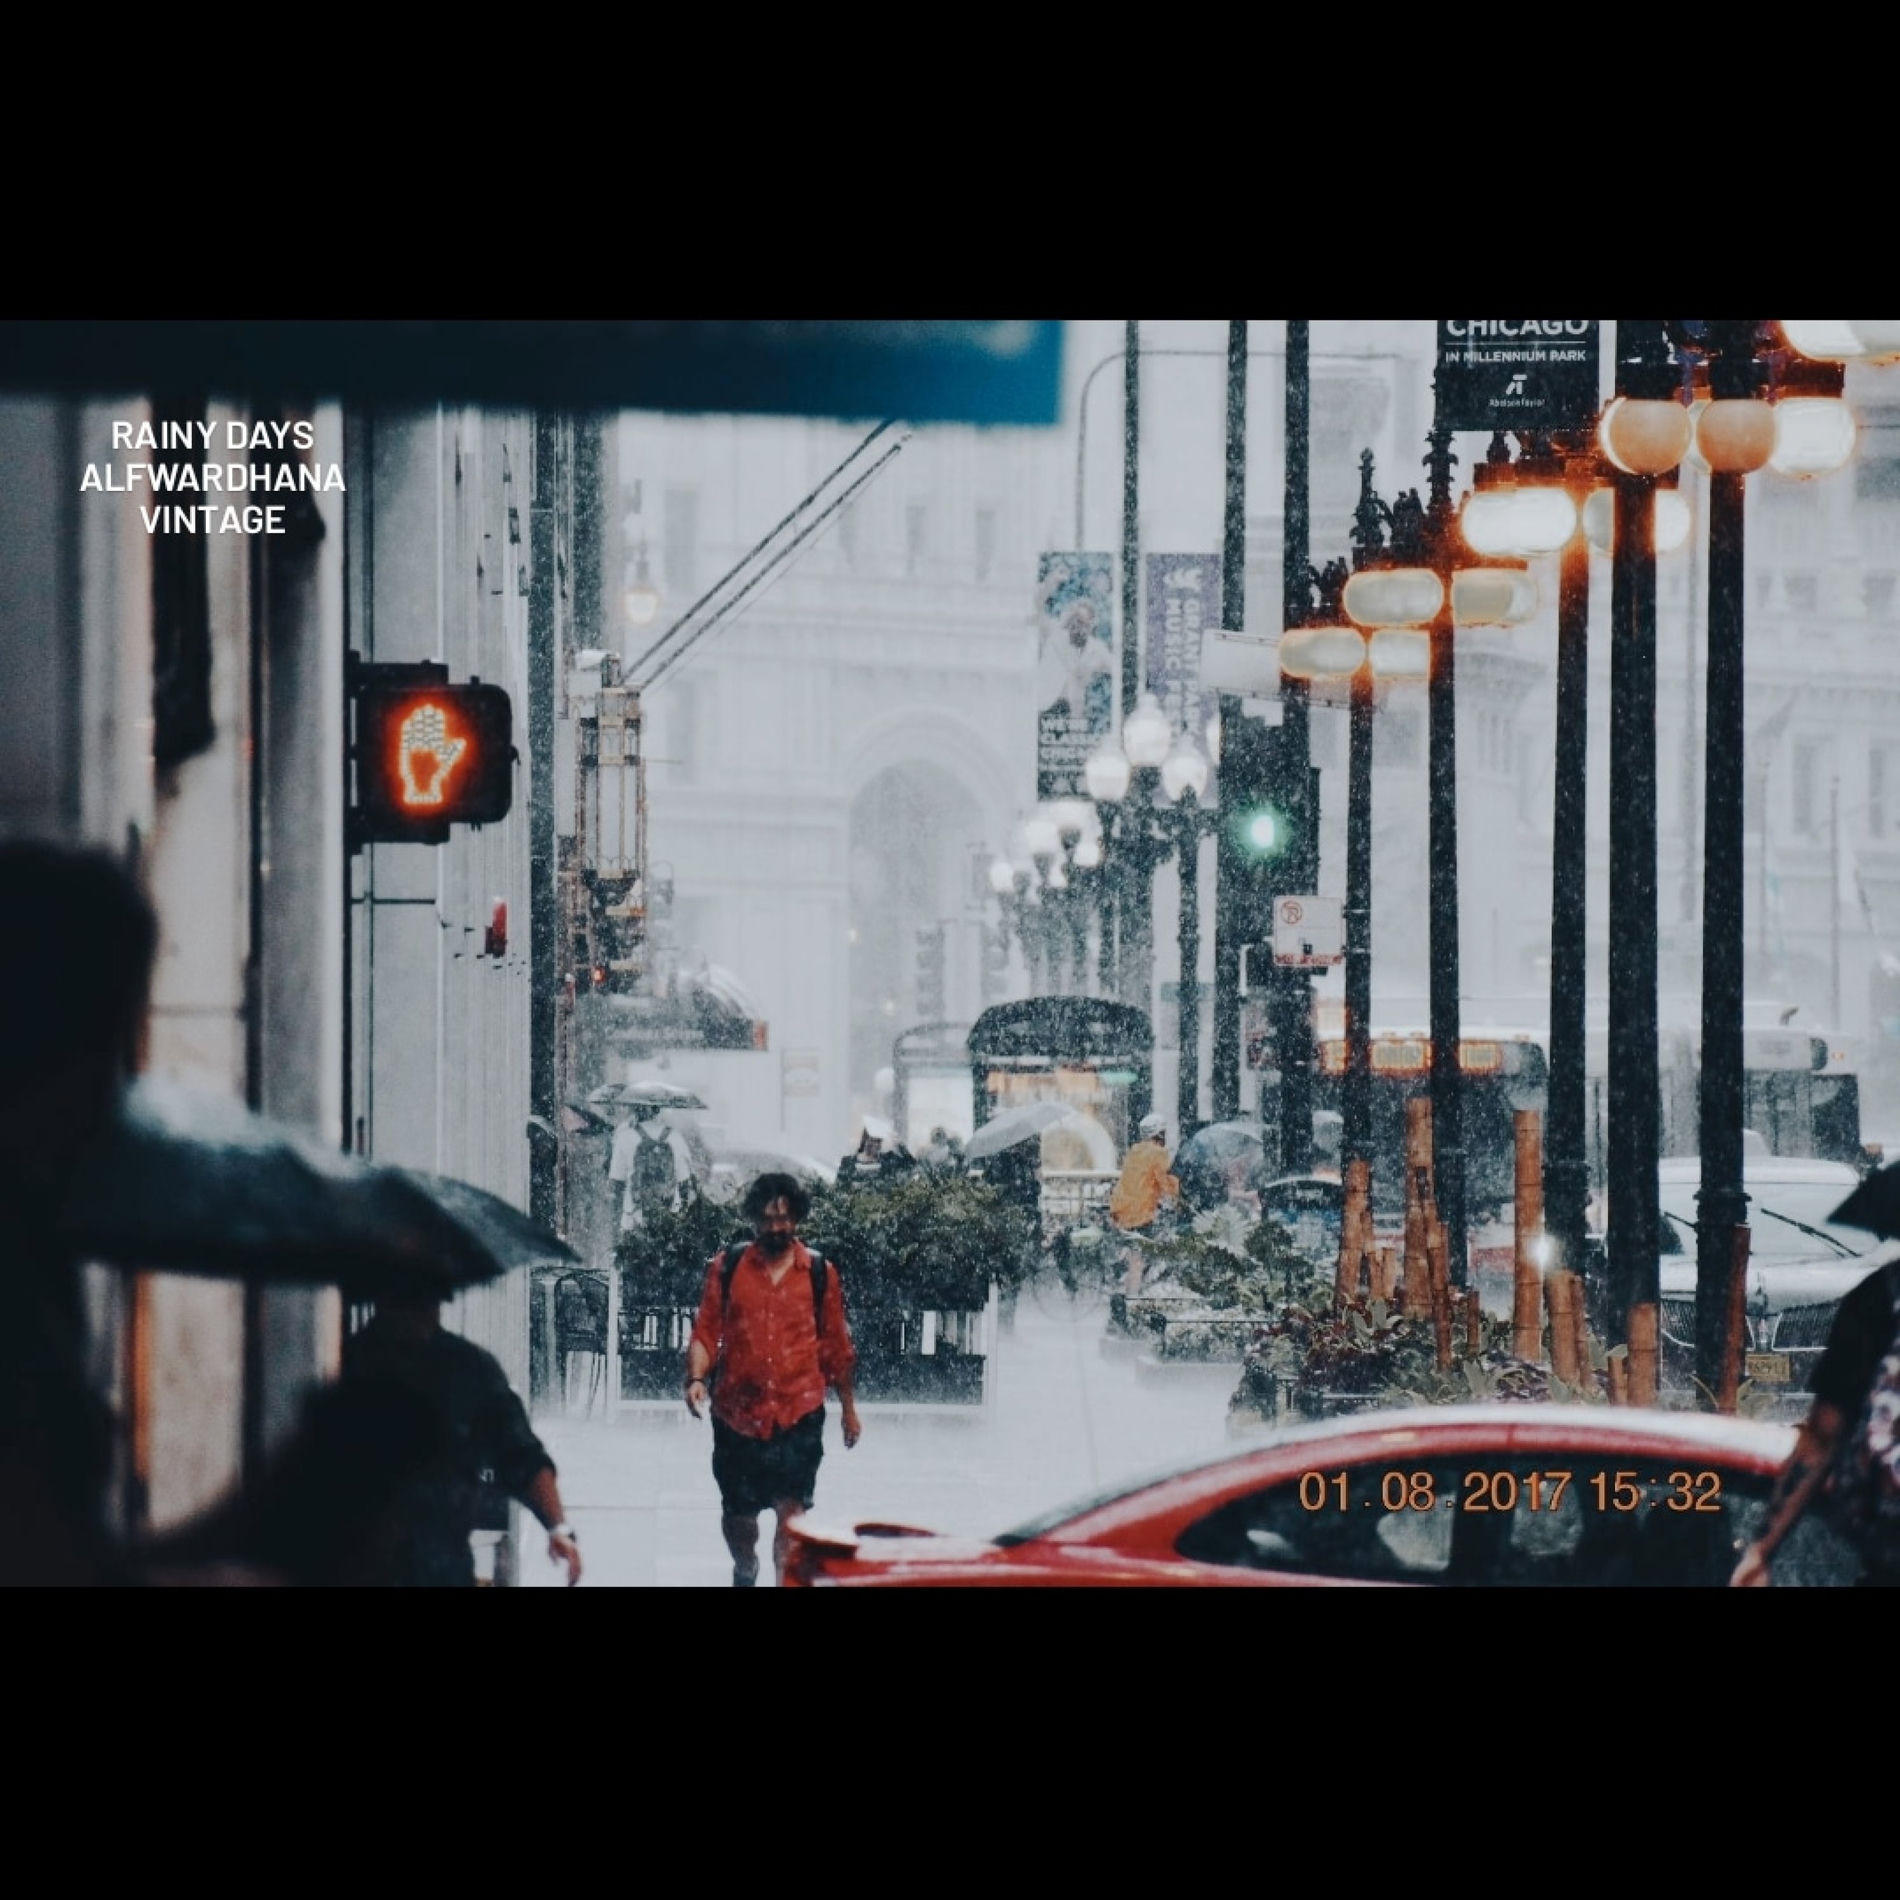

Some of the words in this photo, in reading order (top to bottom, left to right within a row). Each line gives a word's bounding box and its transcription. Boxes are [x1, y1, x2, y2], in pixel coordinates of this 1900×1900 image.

[1446, 320, 1590, 336] CHICAGO
[1445, 351, 1460, 362] IN
[1463, 351, 1546, 362] MILLENNIUM
[1549, 350, 1586, 362] PARK
